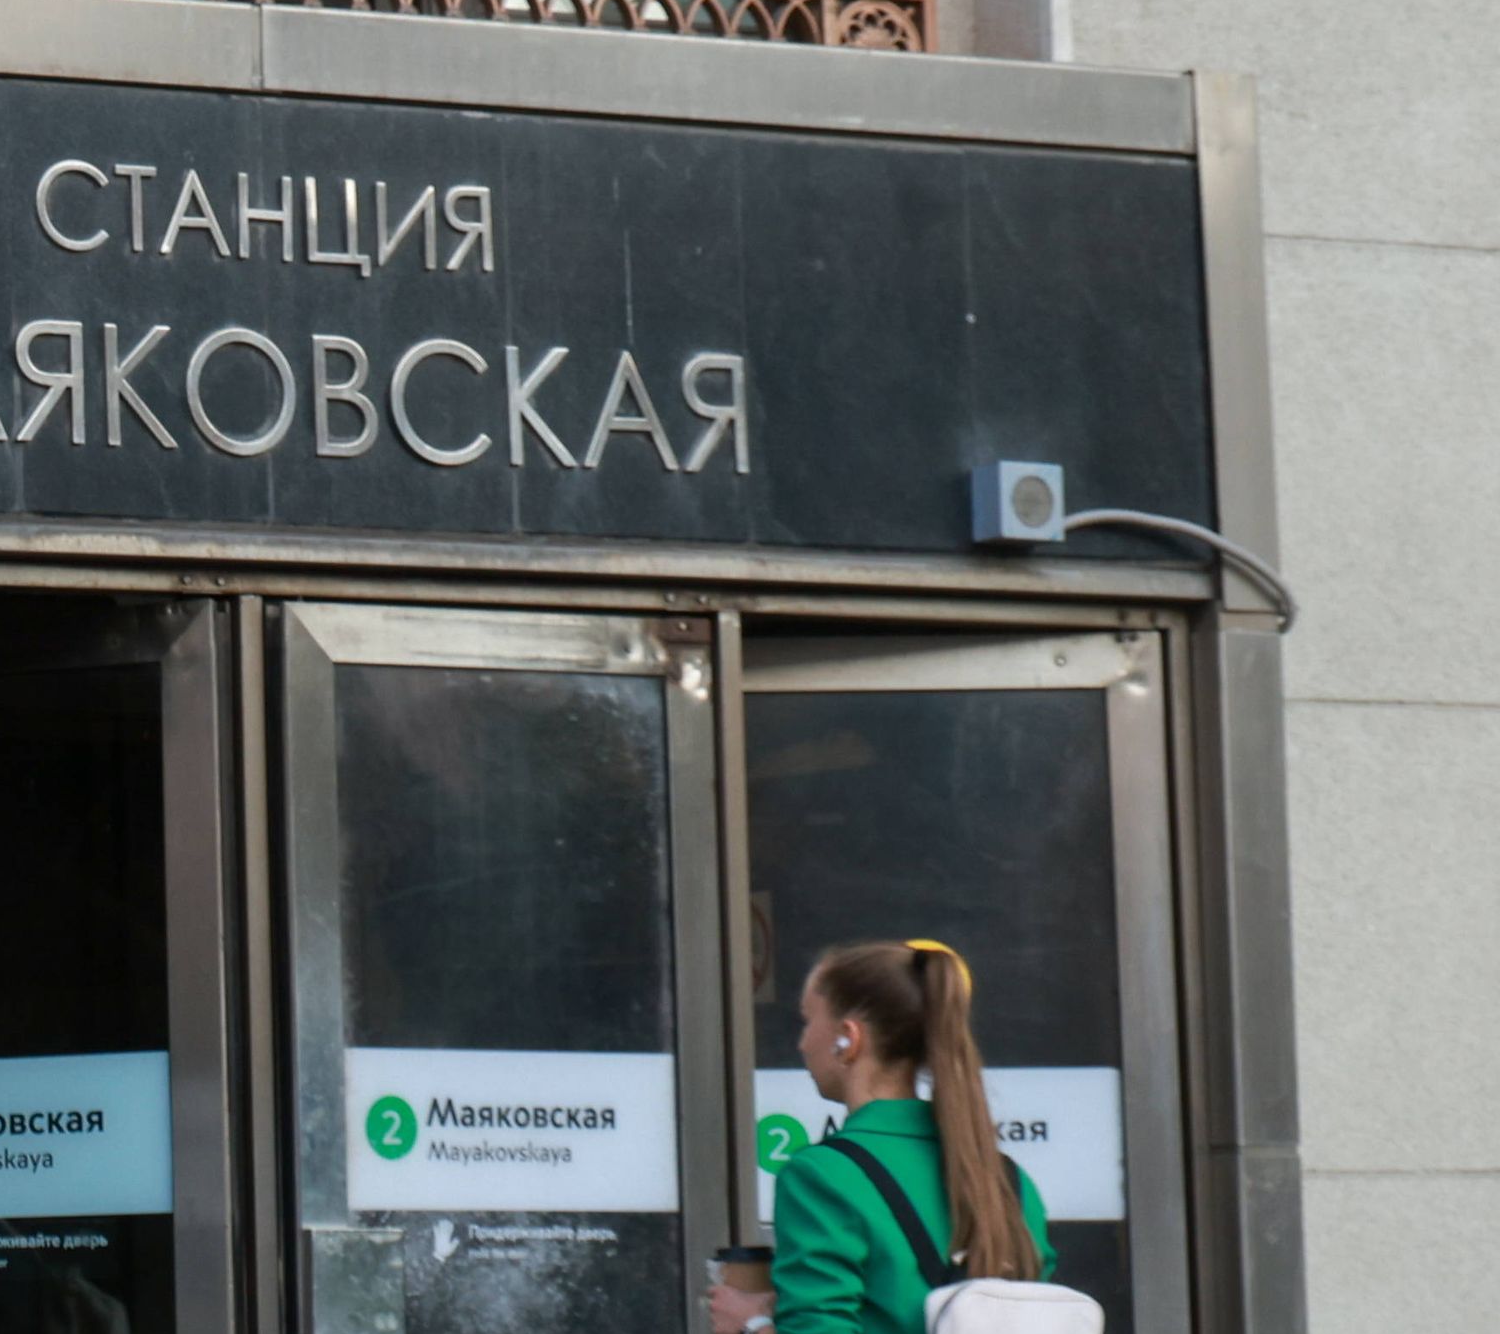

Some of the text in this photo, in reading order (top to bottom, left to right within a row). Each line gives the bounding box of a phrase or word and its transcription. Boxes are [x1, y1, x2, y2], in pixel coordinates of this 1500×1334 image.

[34, 156, 496, 279] СТАНЦИЯ
[381, 1096, 617, 1147] 2 Маяковская
[427, 1139, 574, 1166] Mayakovskaya
[767, 1127, 791, 1162] 2
[62, 1234, 109, 1250] дверь
